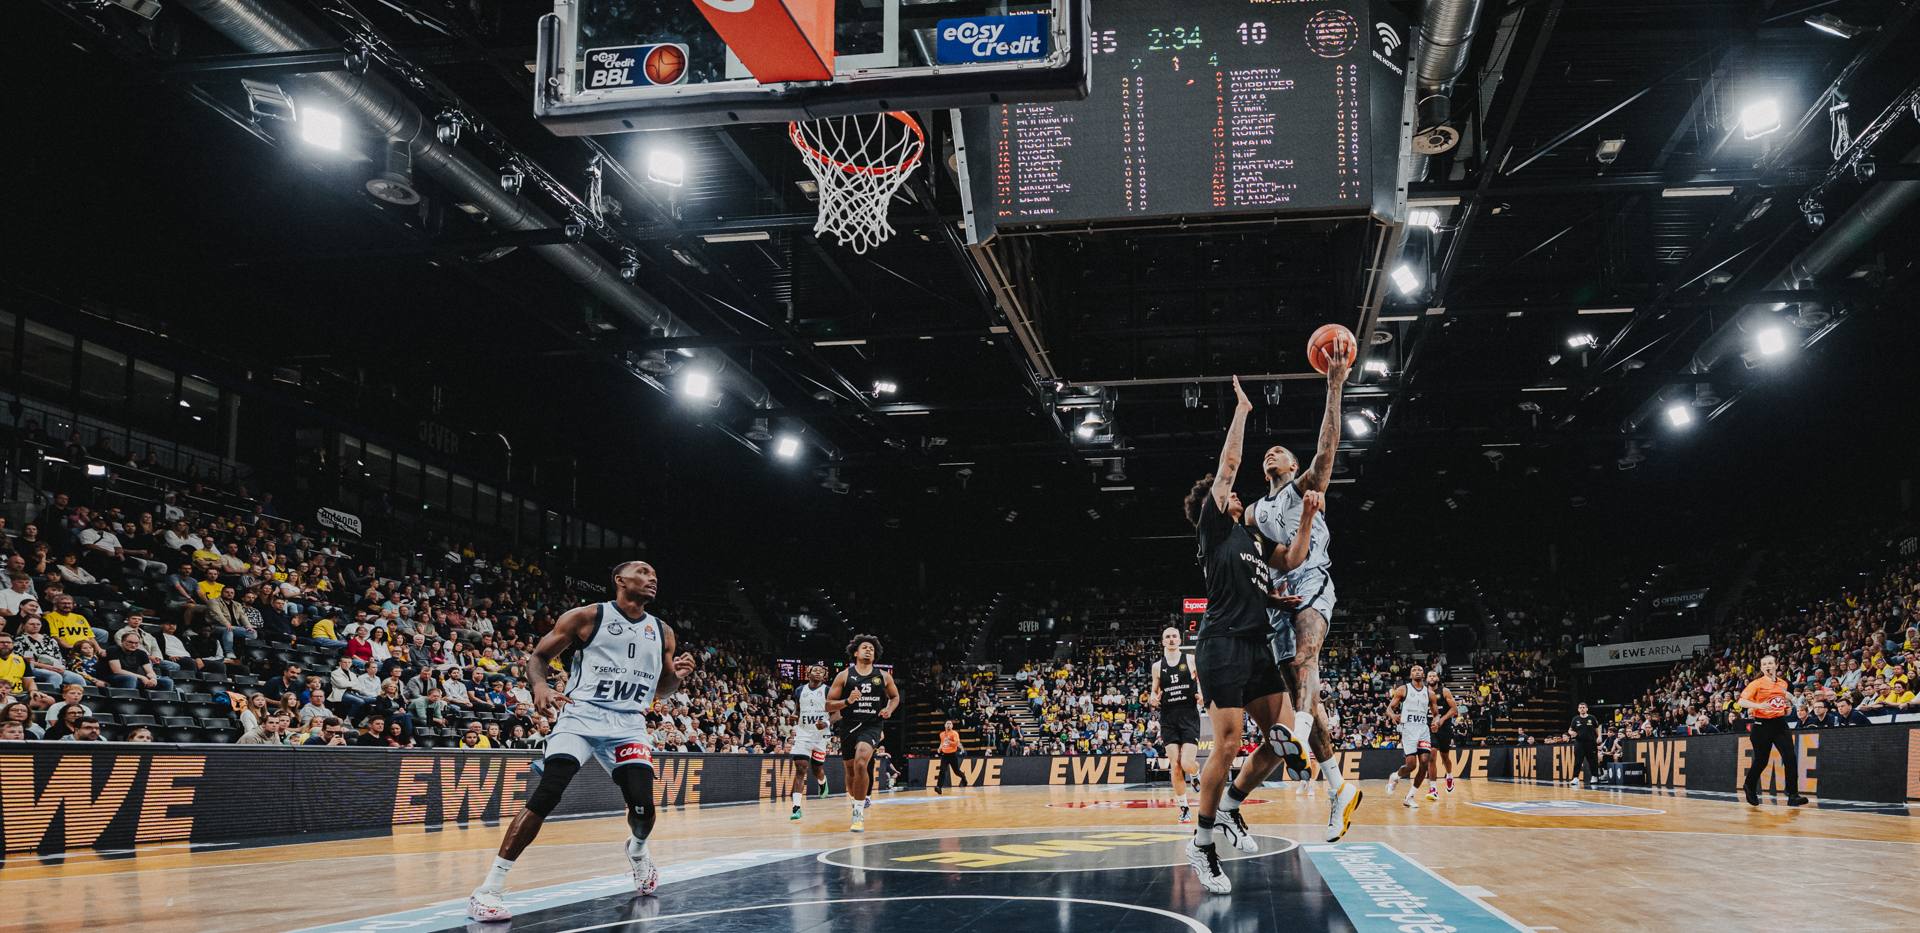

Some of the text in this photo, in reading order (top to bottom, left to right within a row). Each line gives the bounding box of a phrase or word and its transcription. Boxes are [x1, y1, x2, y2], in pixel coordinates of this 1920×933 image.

[1148, 26, 1203, 50] 2:34
[1237, 22, 1267, 45] 10
[972, 36, 1041, 57] Credit
[604, 57, 635, 68] Credit
[1372, 50, 1403, 75] EWE HOTSPOT
[591, 68, 633, 87] BBL
[1229, 69, 1280, 80] WORTHY
[418, 420, 459, 454] JEVER
[1275, 513, 1286, 528] 12
[58, 627, 88, 637] EWE
[1018, 620, 1040, 633] JEVER
[628, 643, 636, 659] 0
[1622, 644, 1682, 658] EWE ARENA
[599, 665, 655, 680] SEMCO VIEBO
[1170, 674, 1179, 684] 15
[593, 680, 649, 704] EWE
[861, 683, 872, 693] 25
[1049, 755, 1128, 784] EWE
[1514, 747, 1537, 778] EWE
[1636, 740, 1687, 787] EWE
[392, 758, 534, 825] EWE
